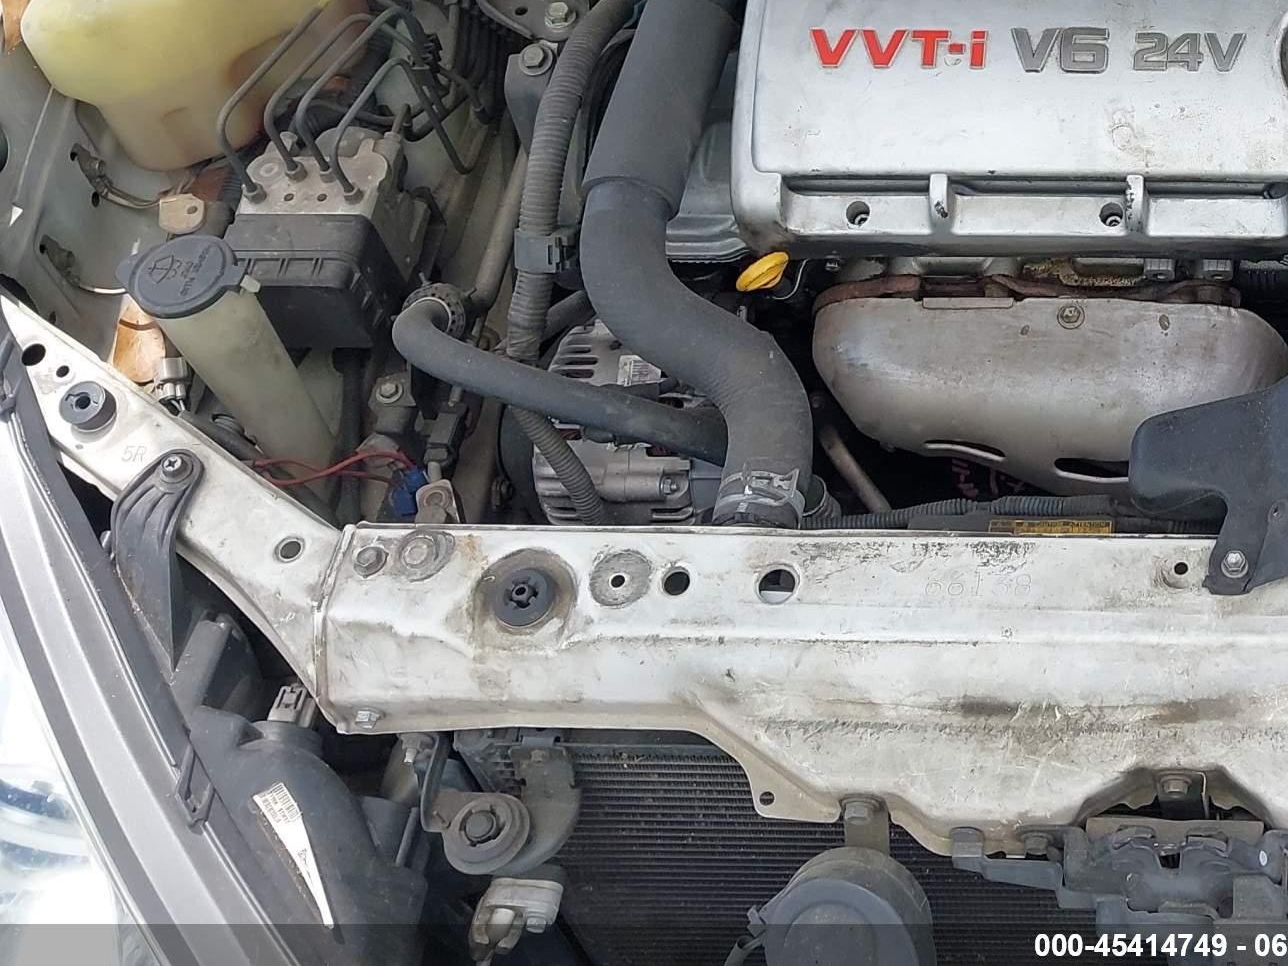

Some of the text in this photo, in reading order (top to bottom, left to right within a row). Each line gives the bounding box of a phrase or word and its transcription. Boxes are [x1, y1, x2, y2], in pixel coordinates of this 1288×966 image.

[810, 27, 1247, 74] VVT-i V6 24V
